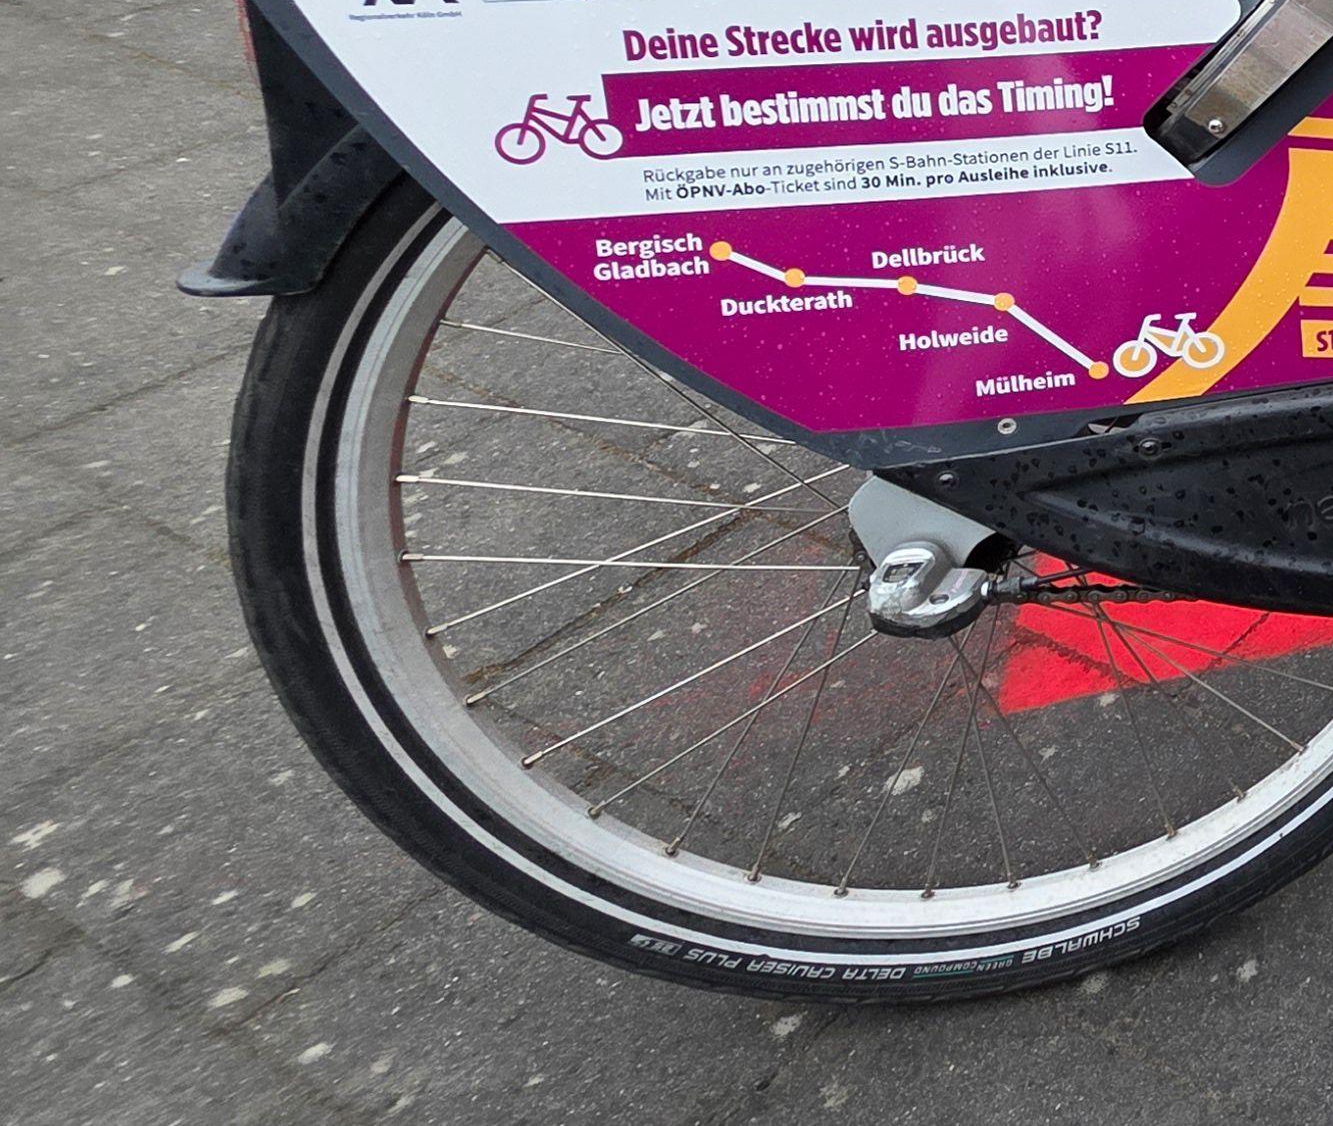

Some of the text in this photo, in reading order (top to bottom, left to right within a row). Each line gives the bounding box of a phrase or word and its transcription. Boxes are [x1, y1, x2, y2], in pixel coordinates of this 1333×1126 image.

[622, 10, 1102, 61] Deine Strecke wird ausgebaut?
[635, 75, 1115, 132] Jetzt bestimmst du das Timing!
[643, 141, 1138, 185] Rückgabe nur an zugehörigen S-Bahn-Stationen der Linie S11.
[645, 160, 1113, 201] Mit ÖPNV-Abo-Ticket sind 30 Min. pro Ausleihe inklusive.
[595, 233, 702, 259] Bergisch
[871, 243, 985, 269] Dellbrück
[593, 256, 710, 281] Gladbach
[720, 290, 853, 317] Duckterath
[899, 326, 1009, 351] Holweide
[975, 371, 1076, 396] Mülheim
[1021, 916, 1141, 964] SCHWALBE
[683, 948, 906, 981] DELTA CRUISER PLUS
[913, 958, 1014, 975] GREEN COMPOUND
